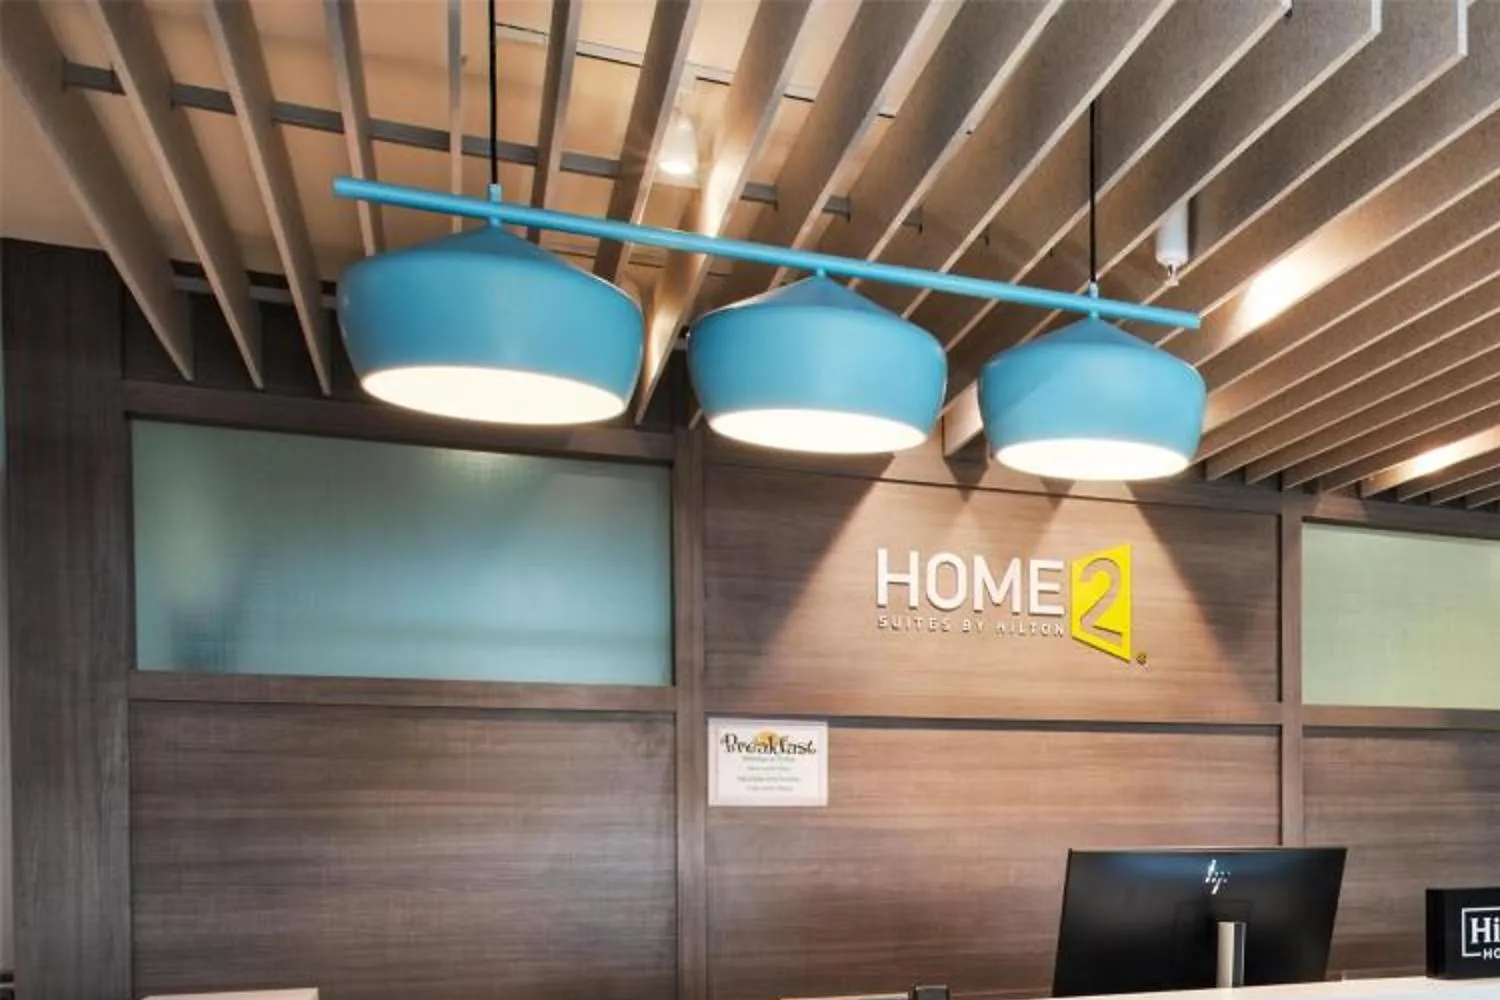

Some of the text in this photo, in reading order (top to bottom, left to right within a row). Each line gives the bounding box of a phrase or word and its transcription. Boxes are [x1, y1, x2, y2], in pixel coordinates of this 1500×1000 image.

[877, 548, 1065, 617] HOME
[877, 614, 1065, 639] SUITES BY HILTON
[720, 732, 817, 756] Breakfast
